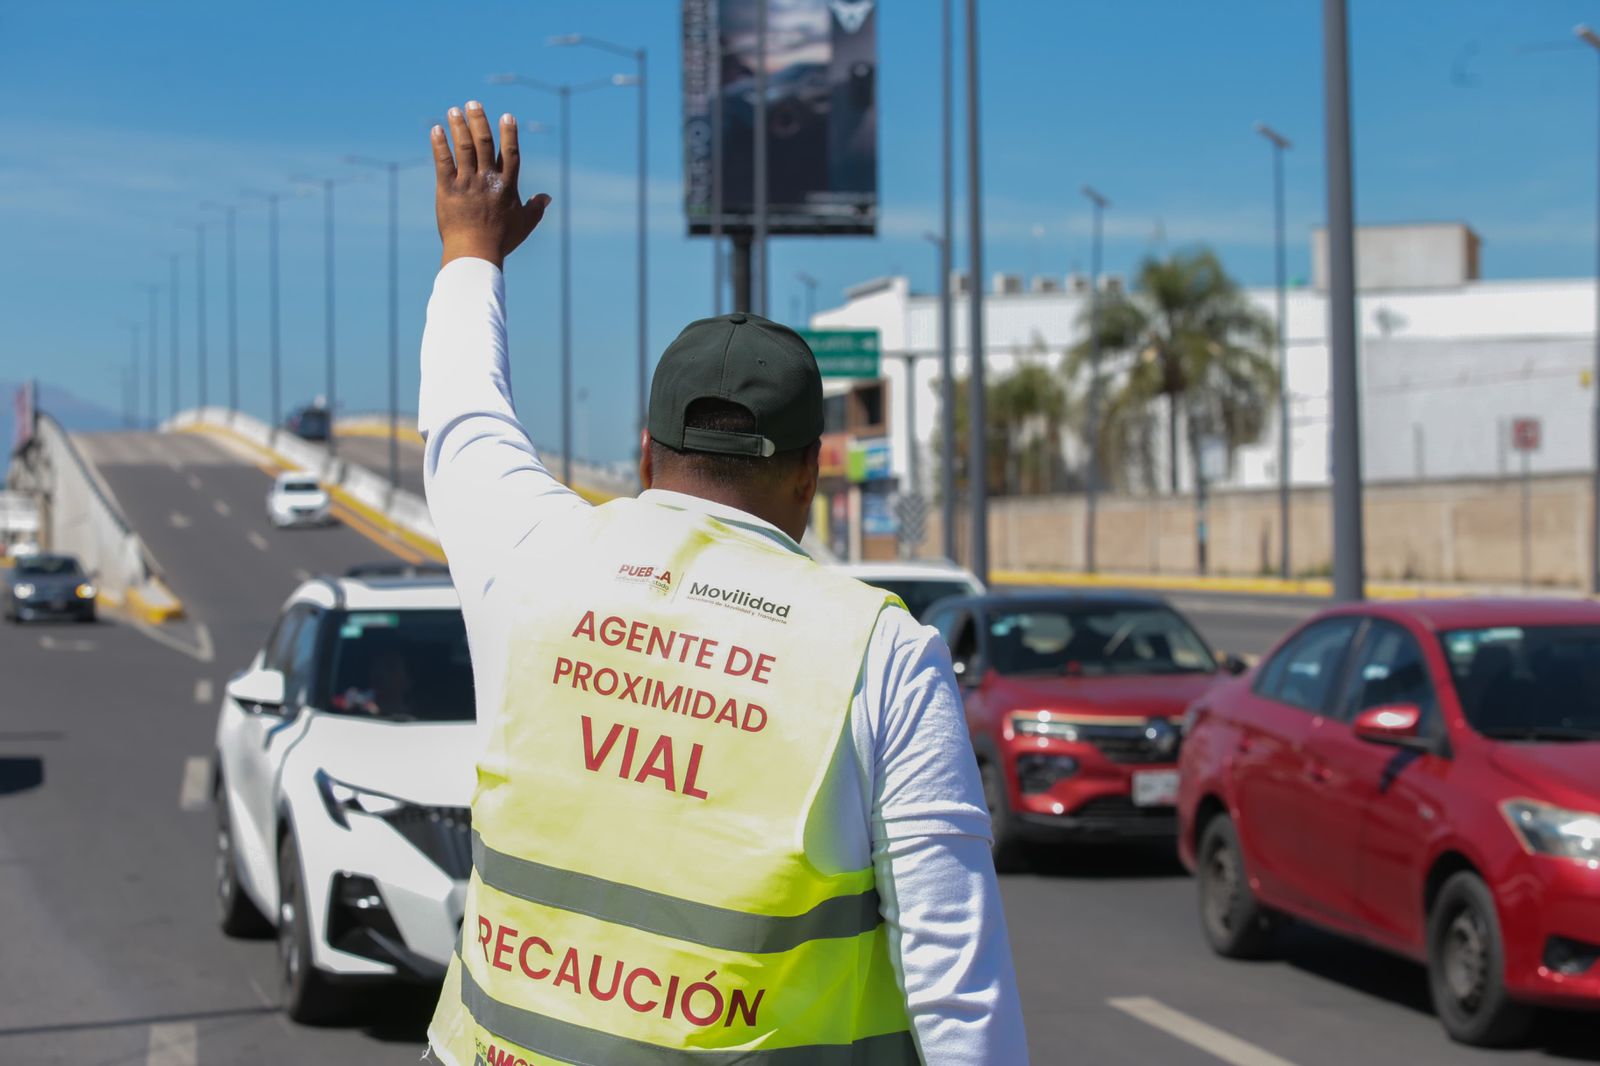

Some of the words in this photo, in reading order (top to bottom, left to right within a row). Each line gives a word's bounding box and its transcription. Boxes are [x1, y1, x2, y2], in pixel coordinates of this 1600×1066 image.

[690, 582, 791, 618] Movilidad
[571, 610, 719, 670] AGENTE
[723, 645, 777, 684] DE
[552, 656, 768, 733] PROXIMIDAD
[581, 715, 708, 800] VIAL
[477, 914, 766, 1028] RECAUCIÓN
